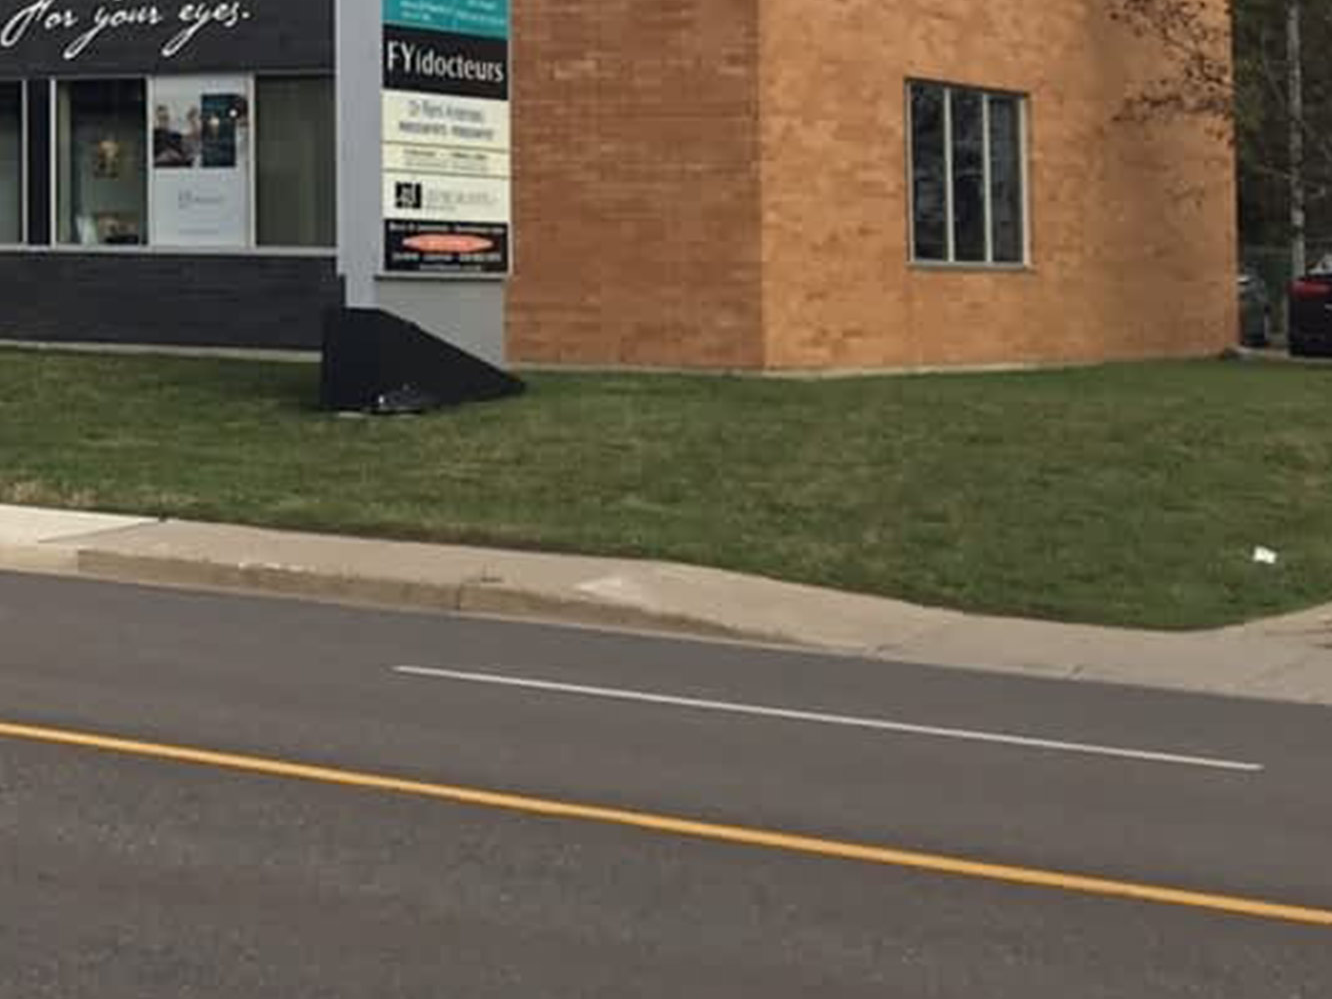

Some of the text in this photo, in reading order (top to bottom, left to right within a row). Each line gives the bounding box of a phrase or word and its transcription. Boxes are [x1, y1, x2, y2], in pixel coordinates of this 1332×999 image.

[61, 4, 165, 61] your
[160, 1, 252, 58] eyes.
[386, 39, 506, 84] FYidocteurs
